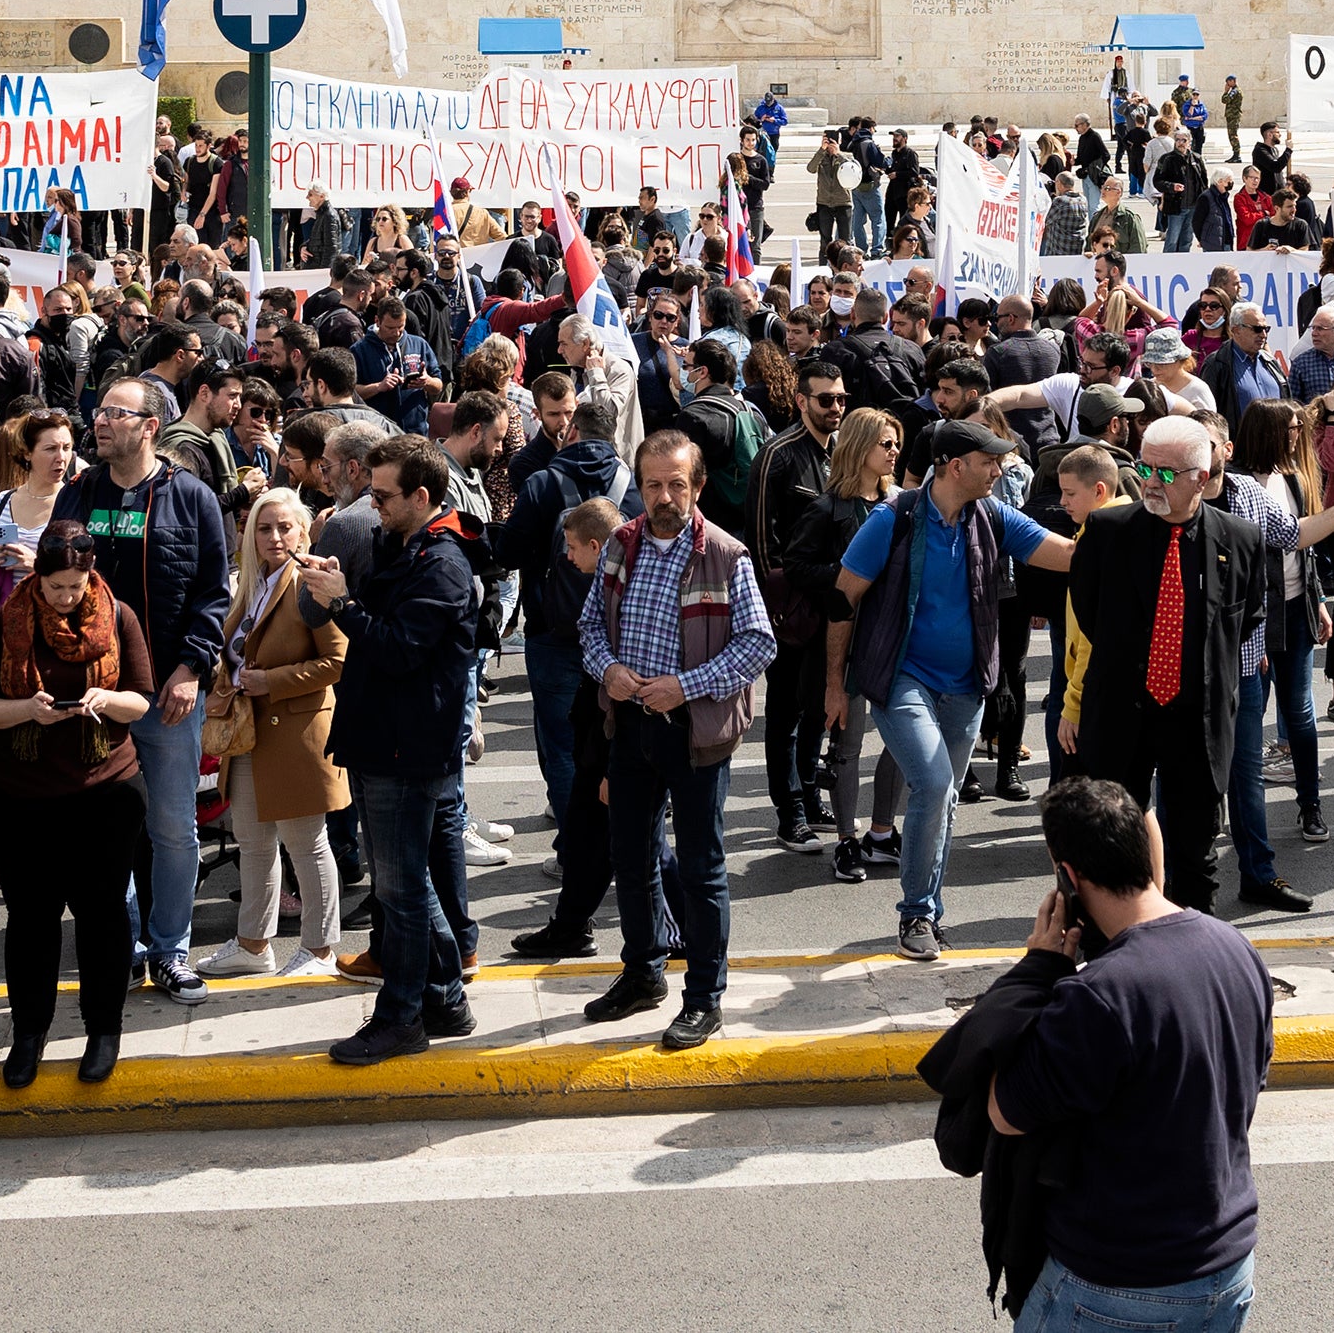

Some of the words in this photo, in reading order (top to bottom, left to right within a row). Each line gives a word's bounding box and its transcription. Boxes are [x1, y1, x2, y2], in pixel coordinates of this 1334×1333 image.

[1304, 45, 1326, 81] Ο
[270, 80, 295, 131] ΤΟ
[478, 77, 510, 130] ΔΕ
[520, 77, 552, 131] ΘΑ
[22, 115, 122, 167] ΑΙΜΑ!
[640, 143, 722, 192] ΕΜΠ
